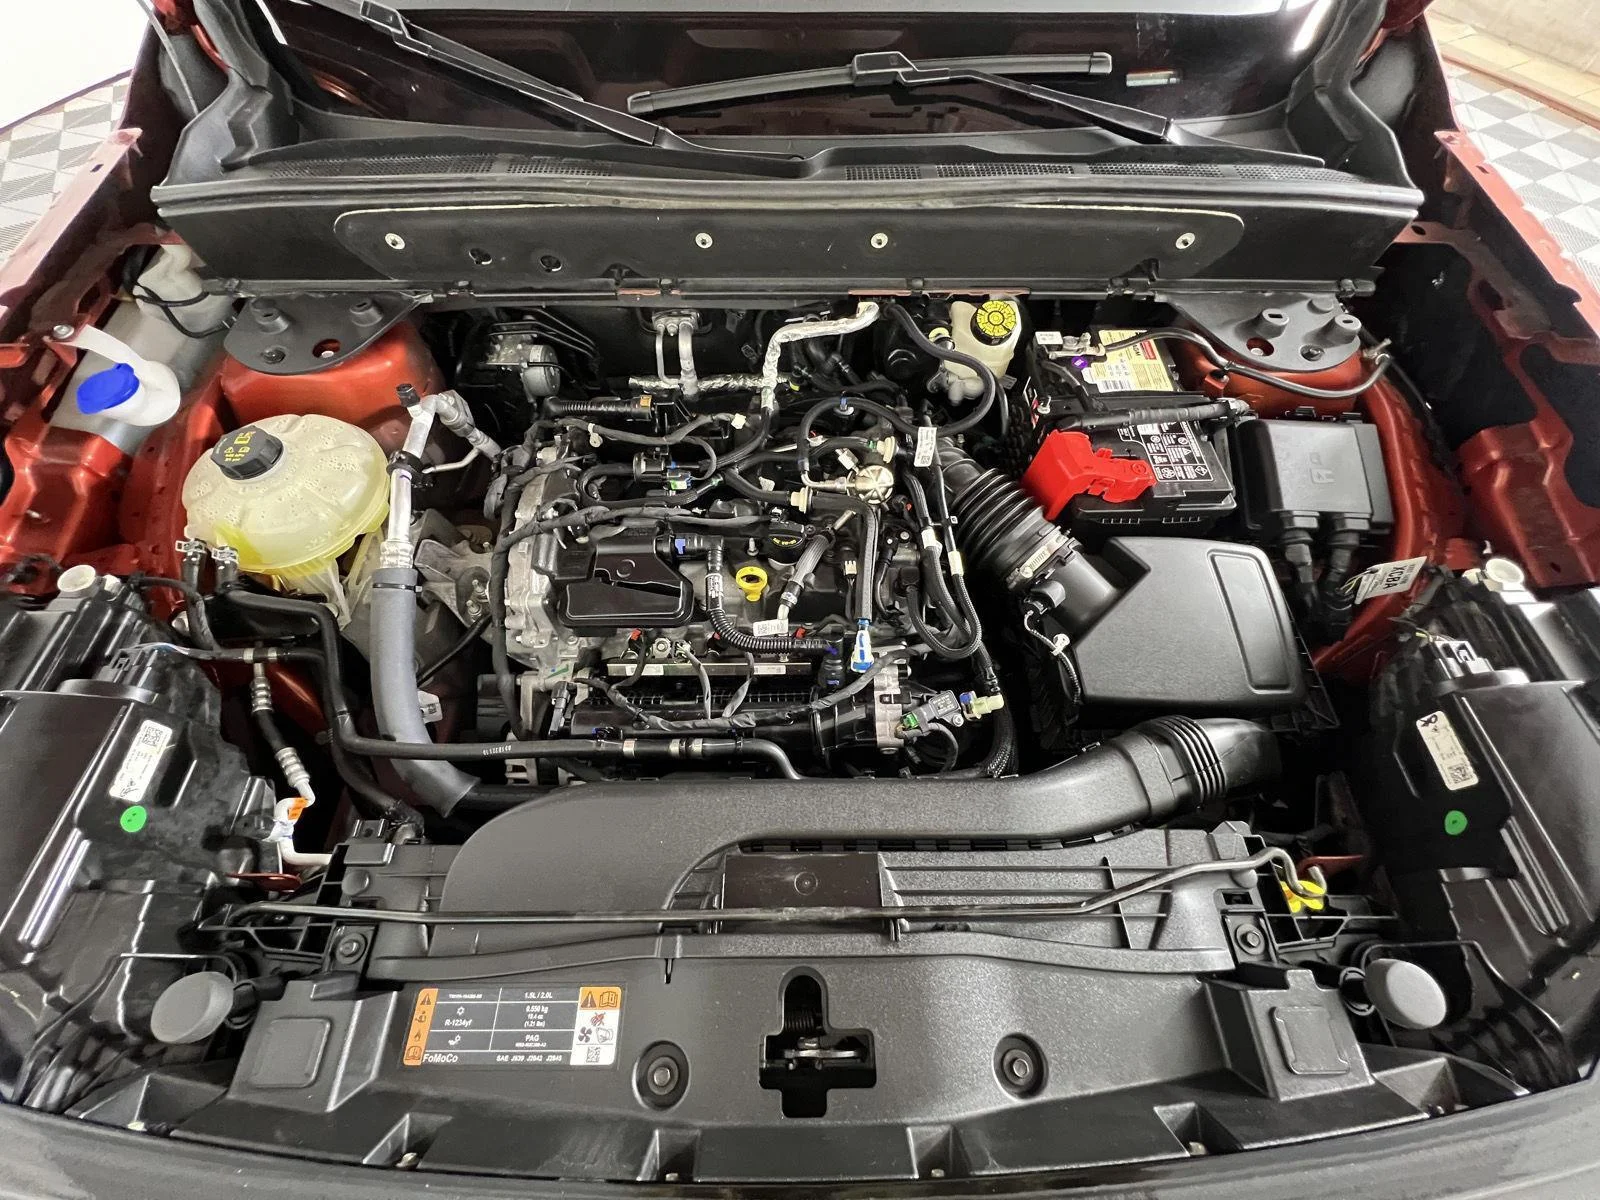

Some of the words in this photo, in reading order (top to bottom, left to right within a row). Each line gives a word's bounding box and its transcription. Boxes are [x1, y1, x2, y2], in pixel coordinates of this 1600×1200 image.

[540, 991, 553, 999] 2.0L
[444, 1018, 473, 1028] R-1234yf
[525, 1034, 540, 1042] PAG
[422, 1053, 459, 1063] FoMoCo
[496, 1054, 509, 1062] SAE
